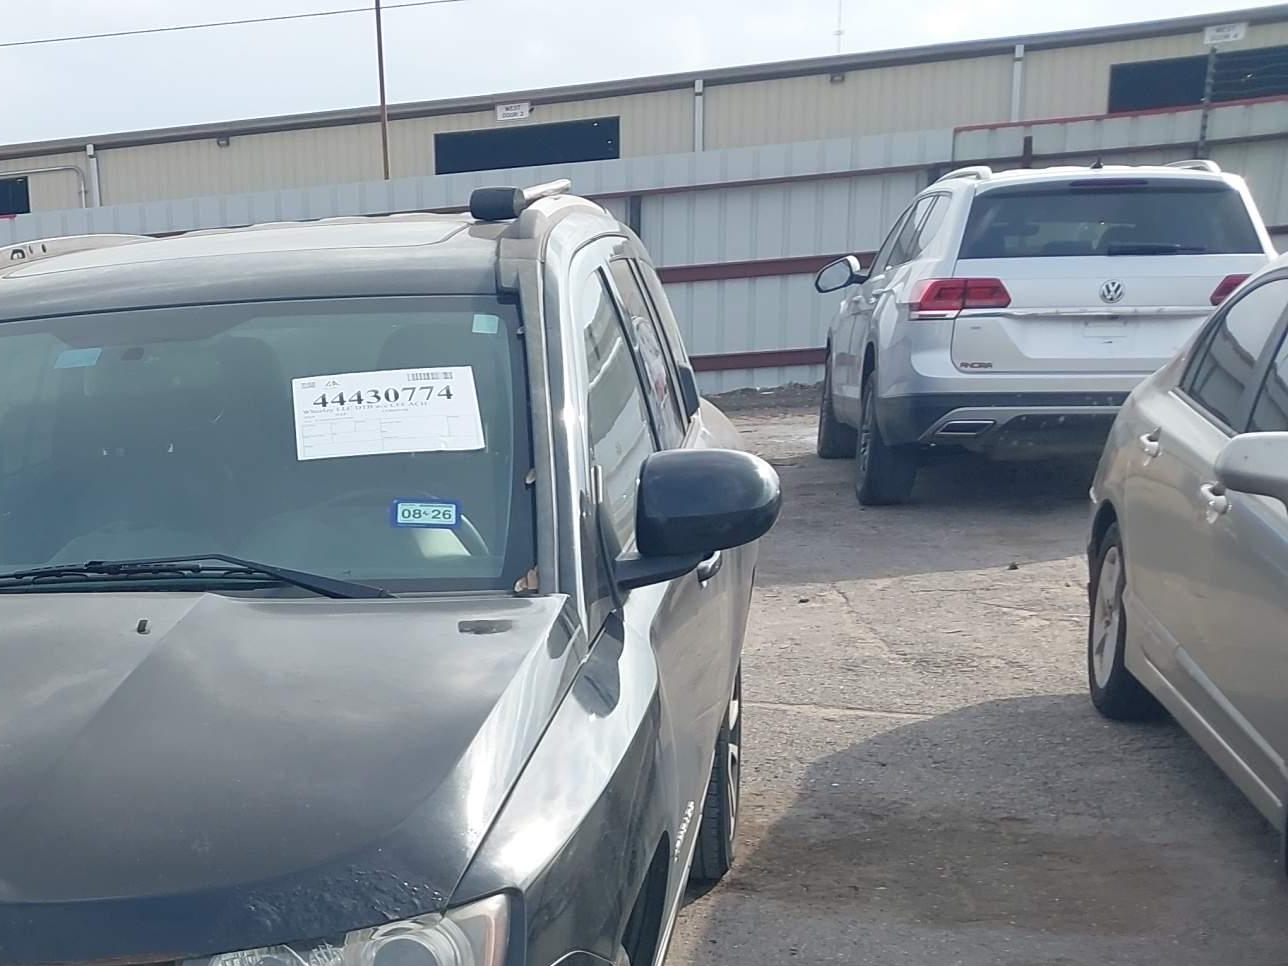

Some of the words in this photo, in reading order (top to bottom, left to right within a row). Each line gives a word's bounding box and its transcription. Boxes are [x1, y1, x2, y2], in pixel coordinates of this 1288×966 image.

[313, 385, 453, 407] 44430774
[402, 508, 422, 519] 08
[431, 509, 452, 520] 26
